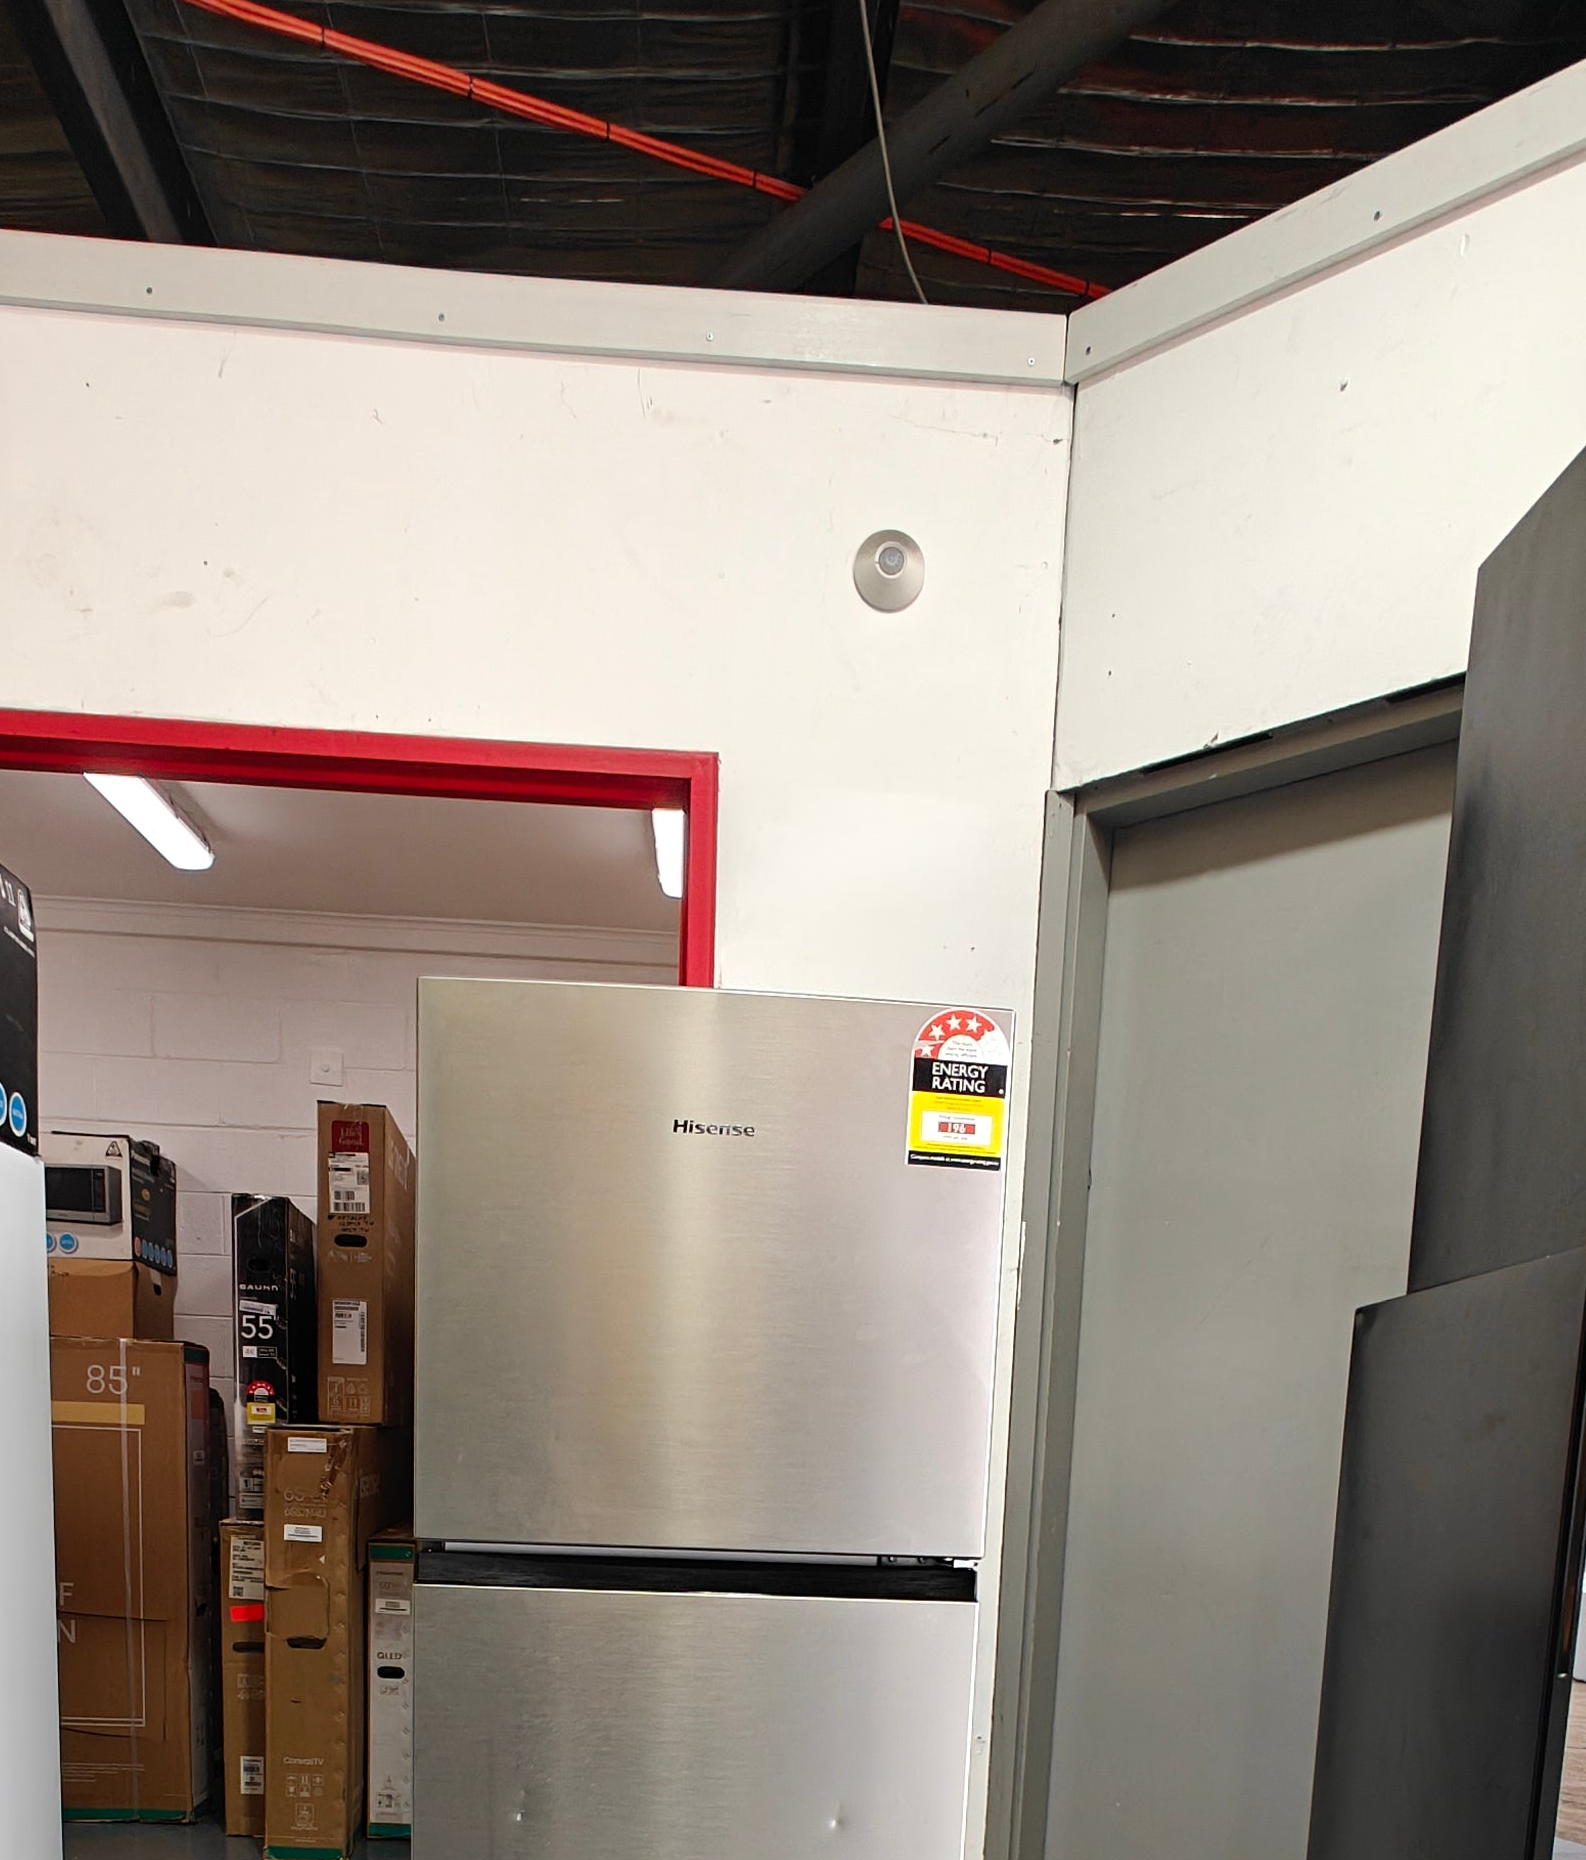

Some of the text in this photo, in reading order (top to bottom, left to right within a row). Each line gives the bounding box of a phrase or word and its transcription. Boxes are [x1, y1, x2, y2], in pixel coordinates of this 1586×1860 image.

[932, 1062, 988, 1079] ENERGY
[931, 1076, 986, 1093] RATING
[673, 1119, 755, 1137] Hisense
[947, 1123, 966, 1133] 196
[86, 1365, 141, 1394] 85"
